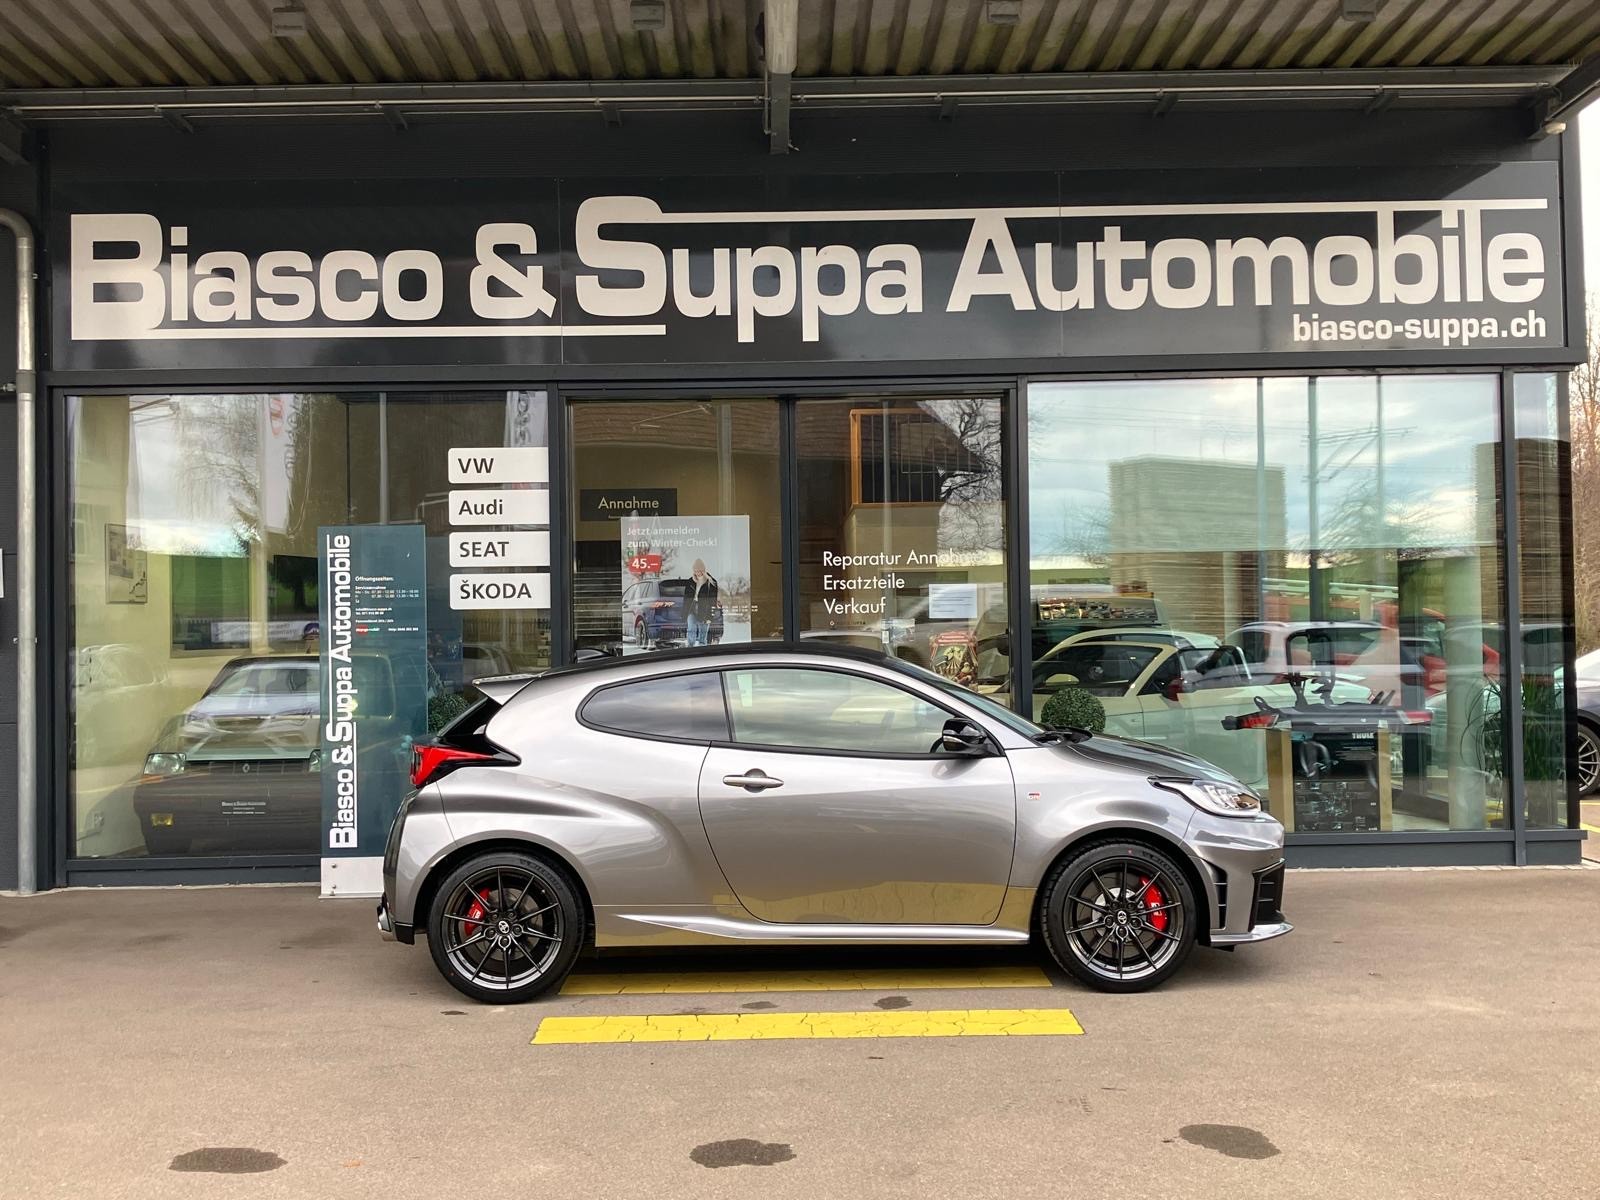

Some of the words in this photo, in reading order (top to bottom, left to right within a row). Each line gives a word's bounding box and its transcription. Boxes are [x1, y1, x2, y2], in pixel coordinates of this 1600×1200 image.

[71, 213, 443, 340] Biasco
[470, 223, 556, 319] &
[576, 196, 922, 343] Suppa
[946, 198, 1546, 312] Automobile
[1293, 311, 1546, 348] biasco-suppa.ch
[457, 458, 494, 474] VW
[458, 499, 503, 516] Audi
[597, 495, 660, 509] Annahme
[627, 527, 650, 536] Jetzt
[653, 526, 700, 536] anmelden
[459, 541, 509, 558] SEAT
[627, 540, 648, 548] zum
[650, 537, 718, 548] Winter-Check!
[823, 549, 902, 570] Reparatur
[459, 579, 532, 600] ŠKODA
[823, 573, 905, 591] Ersatzteile
[328, 534, 352, 663] Automobile
[823, 597, 886, 615] Verkauf
[326, 667, 358, 742] Suppa
[332, 745, 353, 765] &
[330, 769, 358, 848] Biasco
